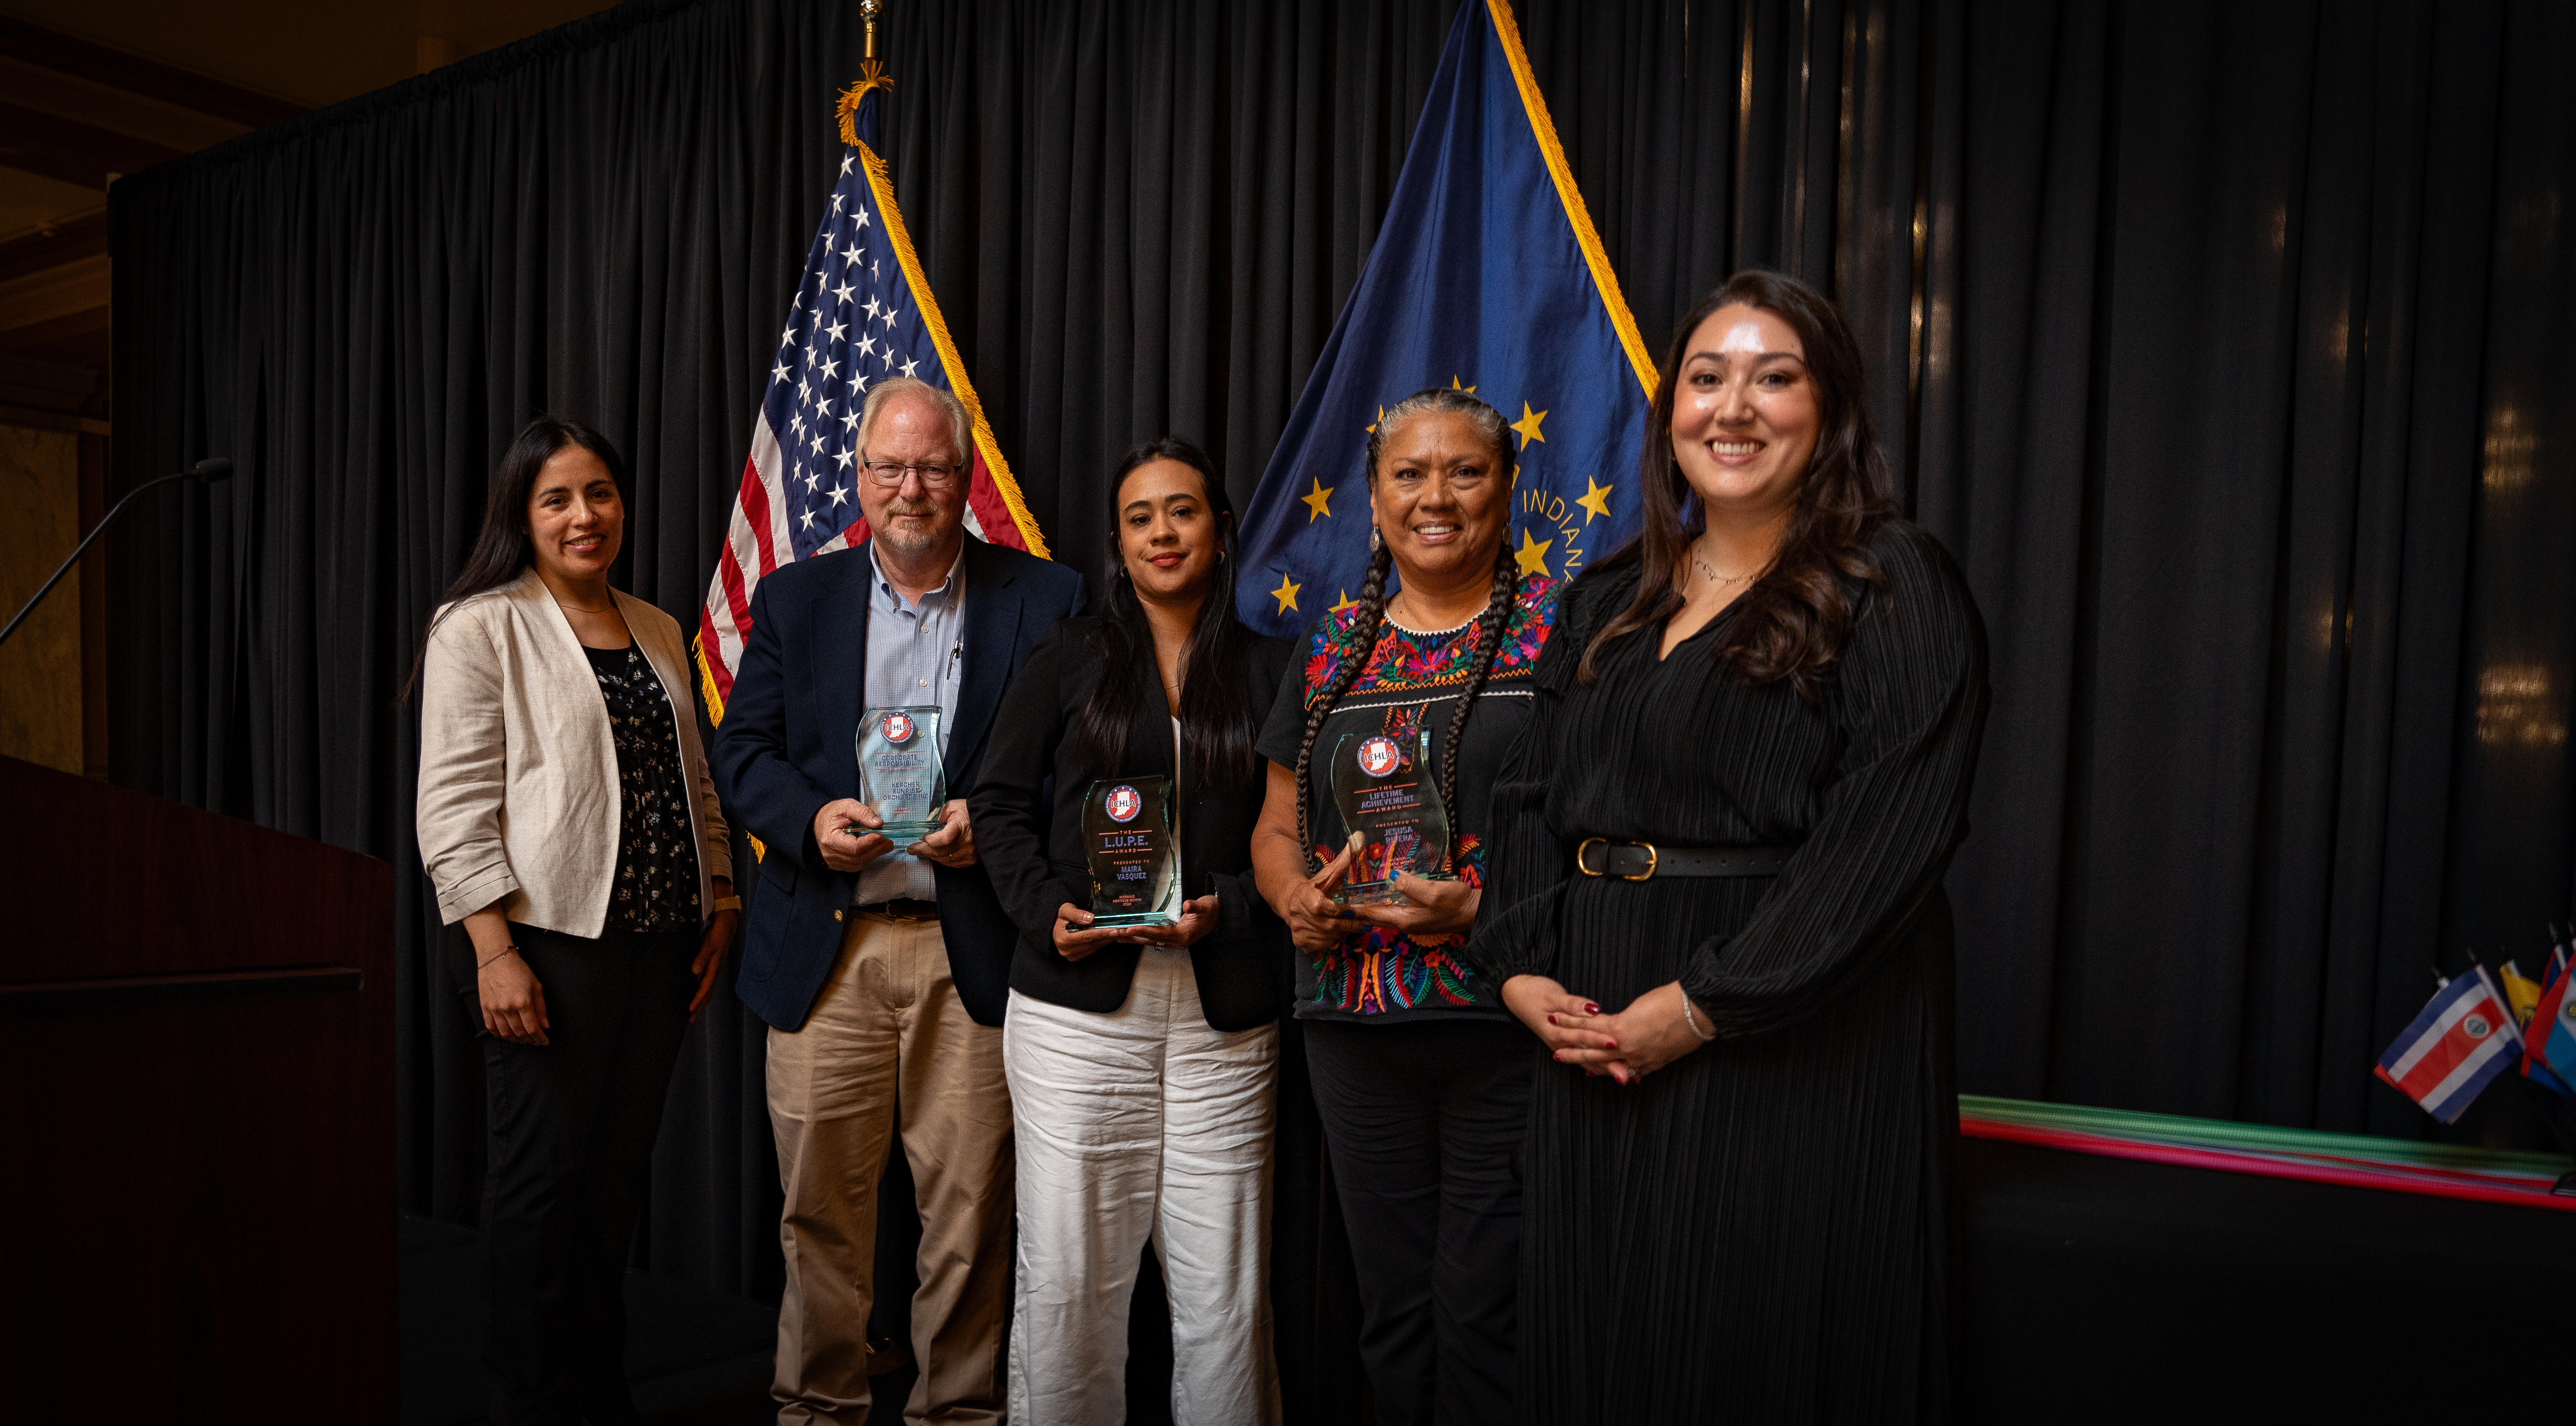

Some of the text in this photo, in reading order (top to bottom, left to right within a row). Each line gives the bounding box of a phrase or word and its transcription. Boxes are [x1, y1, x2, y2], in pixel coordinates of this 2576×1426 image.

[1365, 751, 1394, 762] ICHLA
[1370, 789, 1403, 800] LIFETIME
[1111, 799, 1135, 808] ICHLA
[1361, 795, 1414, 809] ACHIEVEMENT
[1384, 826, 1413, 836] JESUSA
[1105, 835, 1148, 848] L.U.P.E.
[1117, 872, 1146, 881] VASQUEZ
